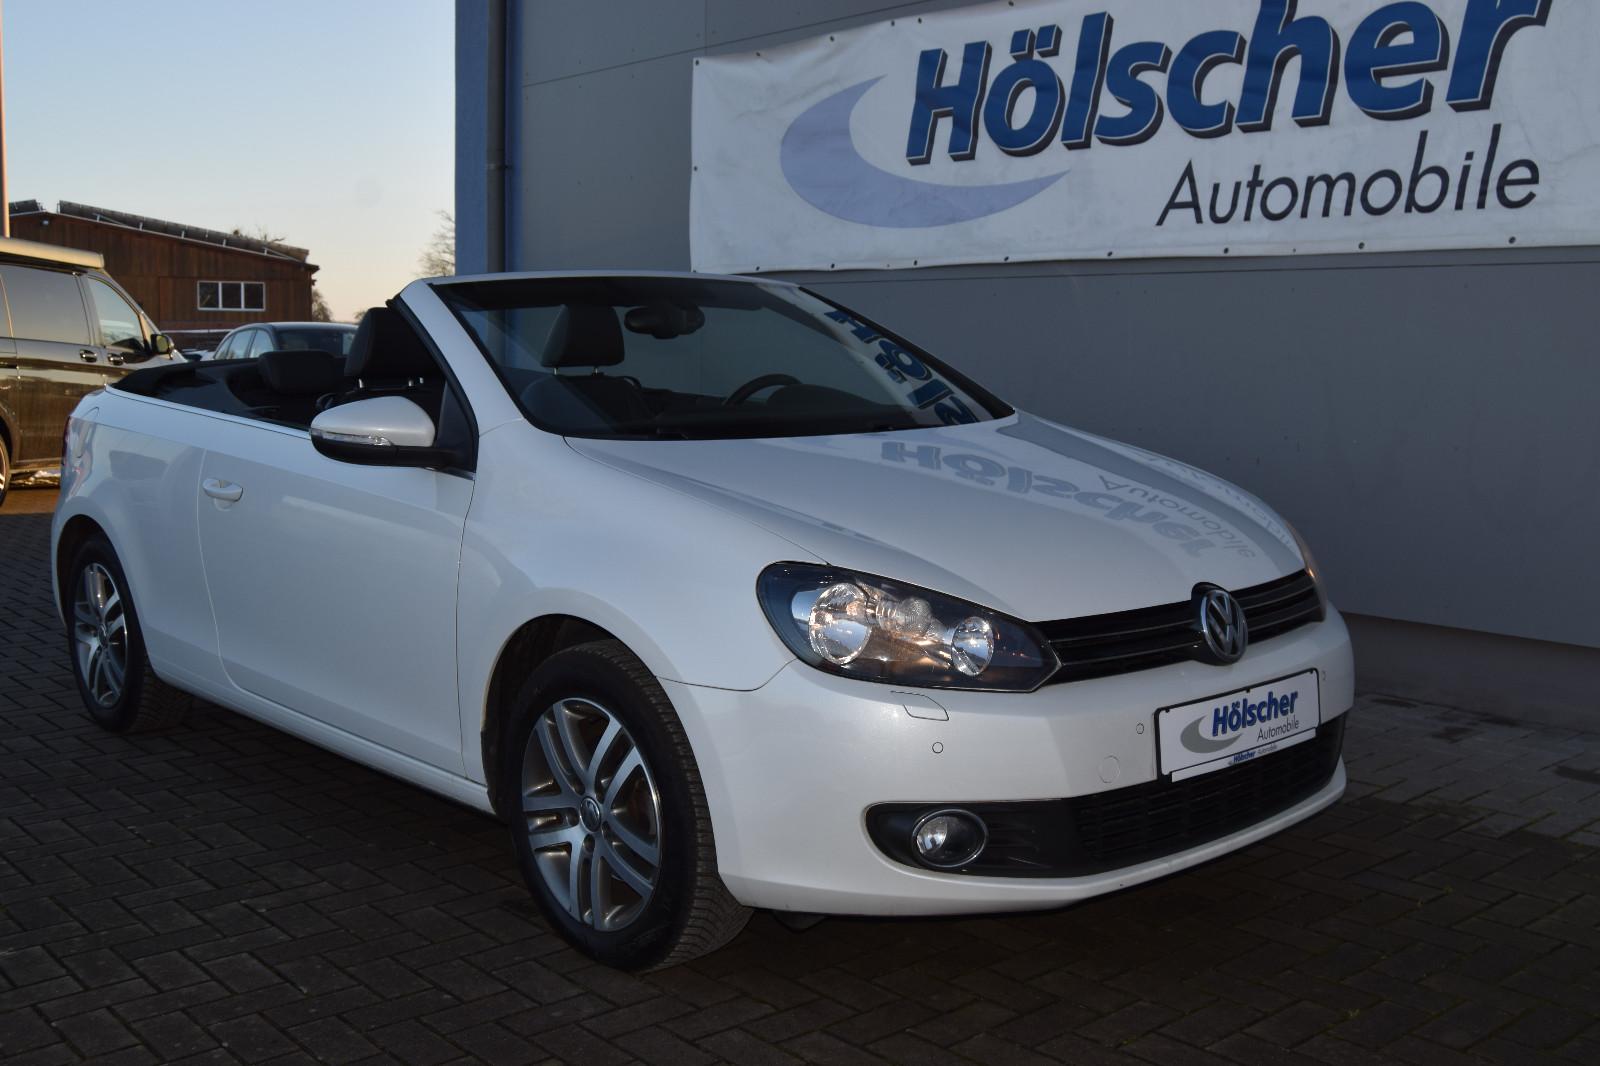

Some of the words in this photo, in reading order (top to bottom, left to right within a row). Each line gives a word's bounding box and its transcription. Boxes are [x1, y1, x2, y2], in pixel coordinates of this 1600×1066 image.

[906, 0, 1552, 166] Hölscher
[1156, 123, 1540, 226] Automobile
[1212, 690, 1299, 737] Hölscher
[1256, 714, 1300, 743] Automobile
